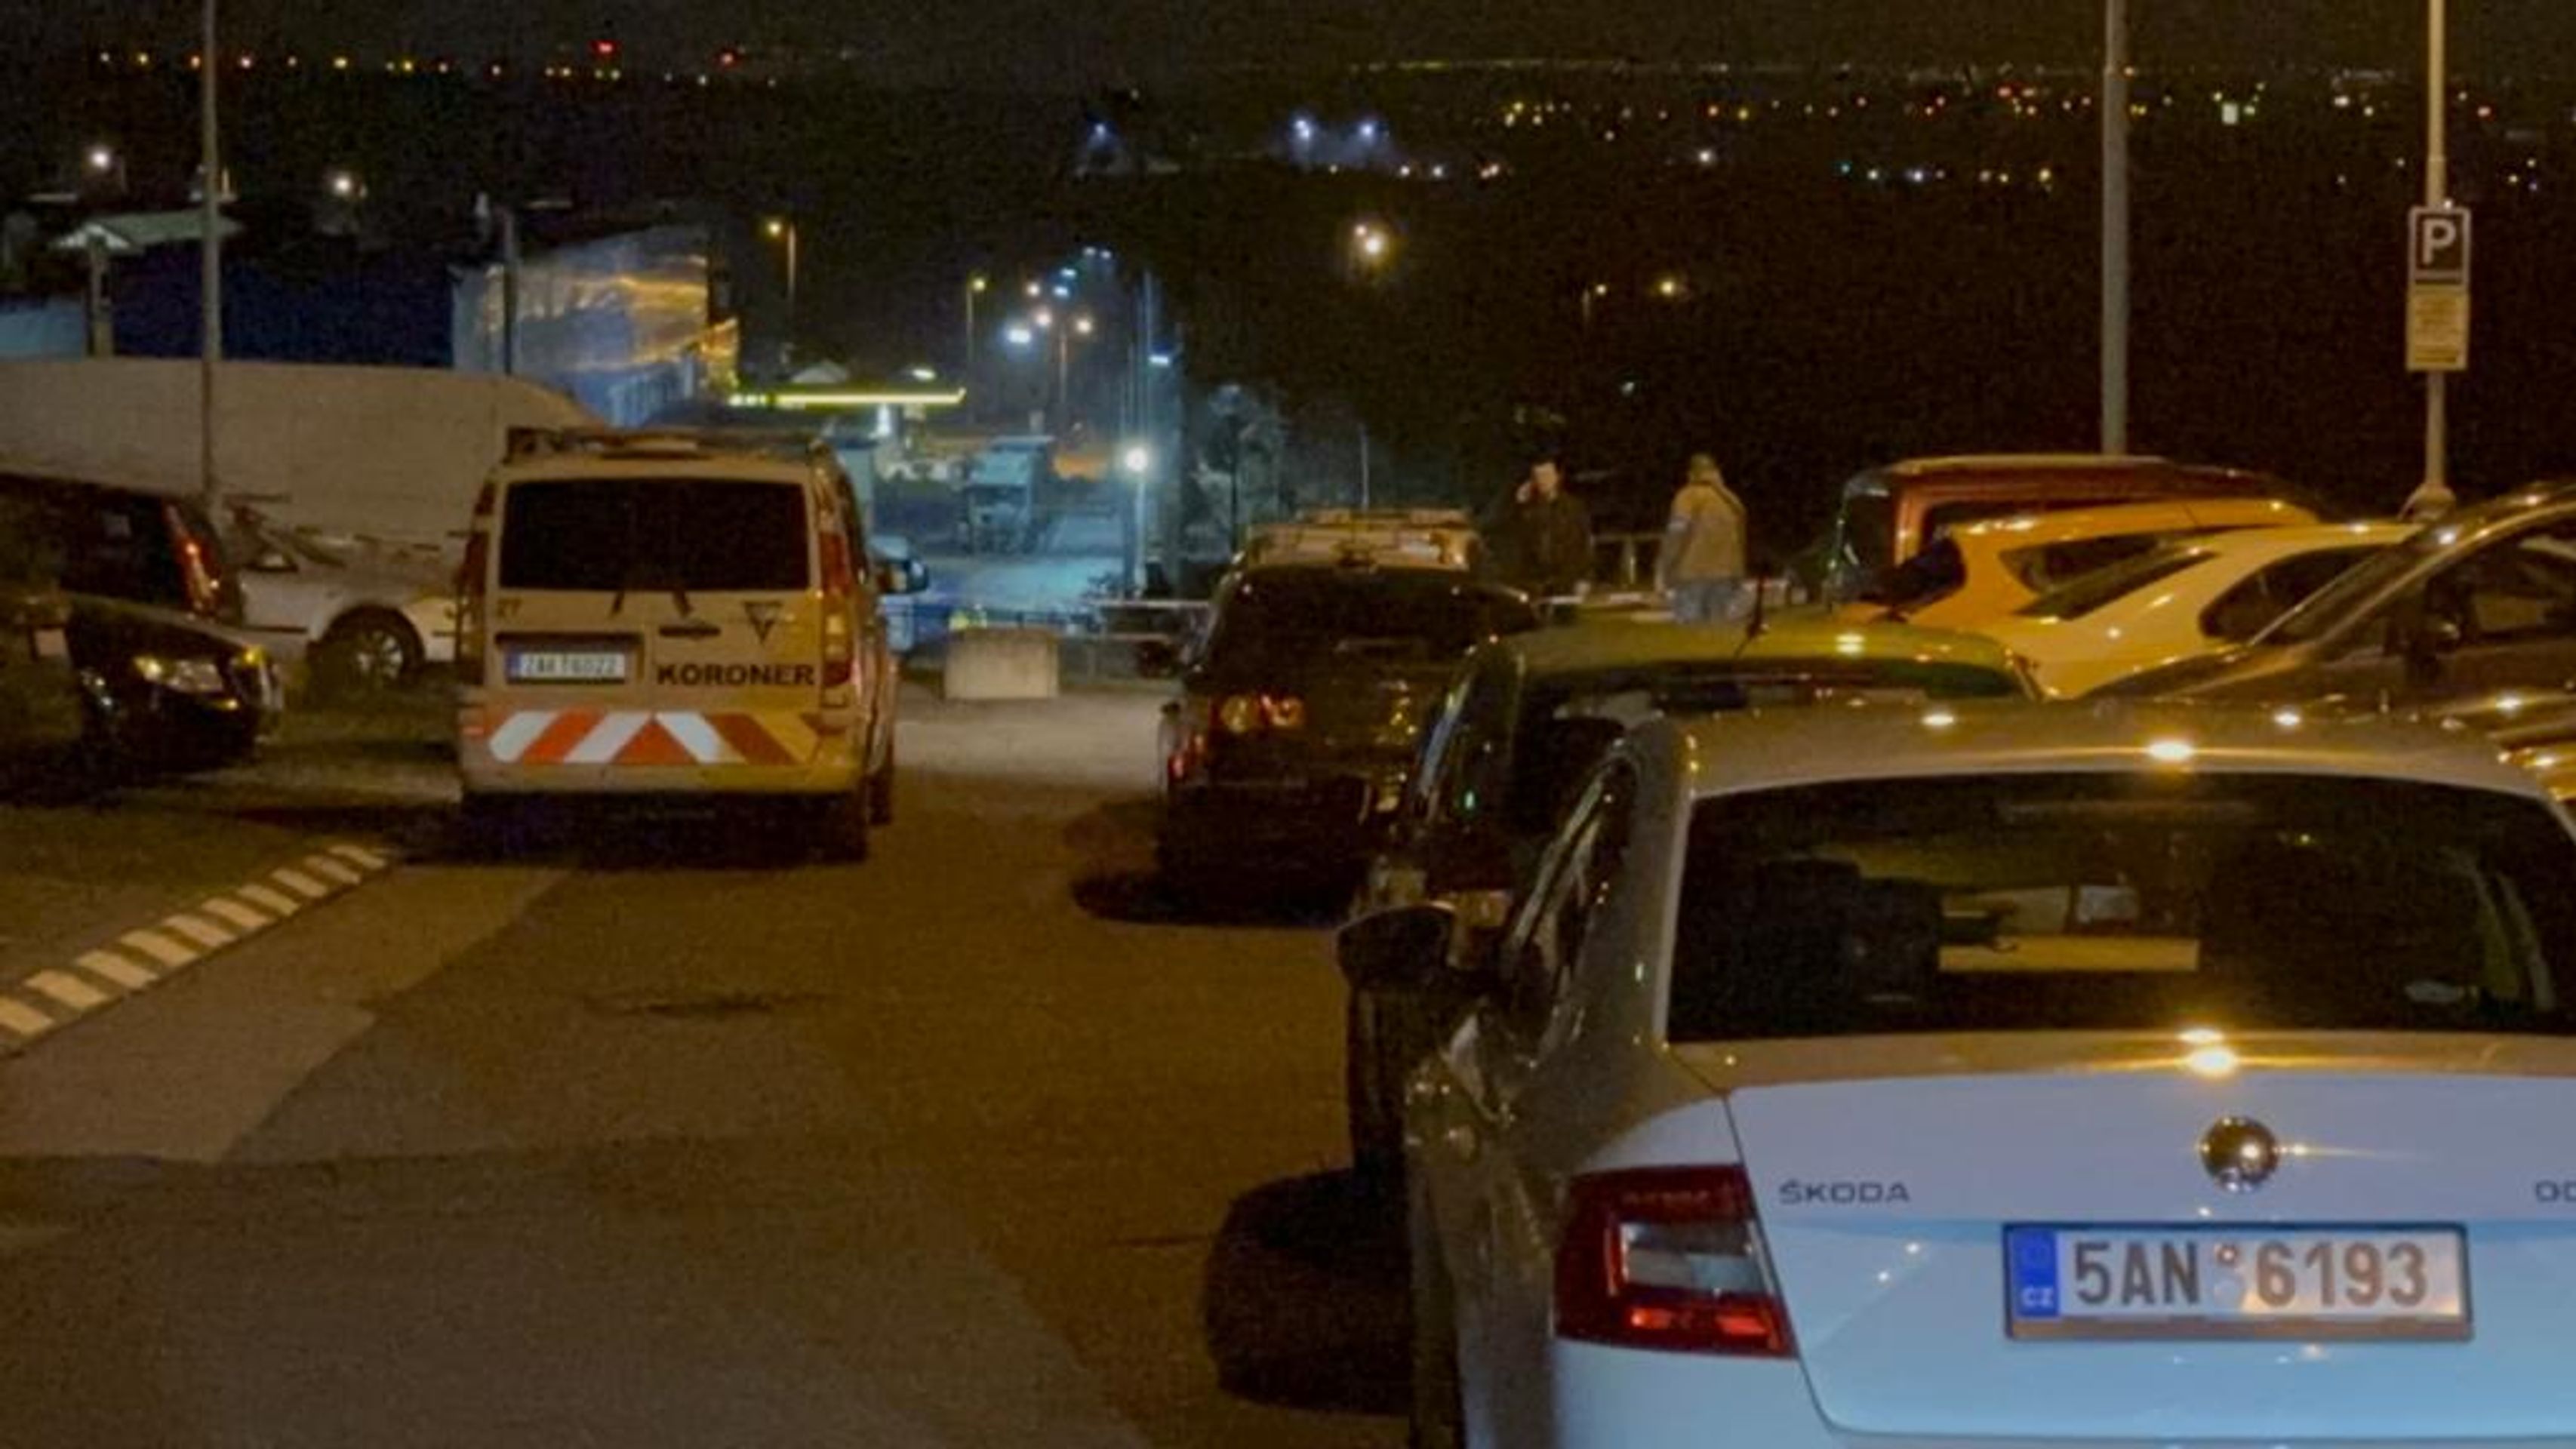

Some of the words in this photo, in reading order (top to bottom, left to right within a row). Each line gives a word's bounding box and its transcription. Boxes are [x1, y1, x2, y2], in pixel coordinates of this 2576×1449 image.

[2422, 218, 2456, 264] P
[656, 663, 814, 685] KORONER
[1779, 1179, 1910, 1204] ŠKODA
[2074, 1241, 2201, 1306] 5AN
[2255, 1241, 2427, 1307] 6193
[2022, 1287, 2053, 1306] CZ
